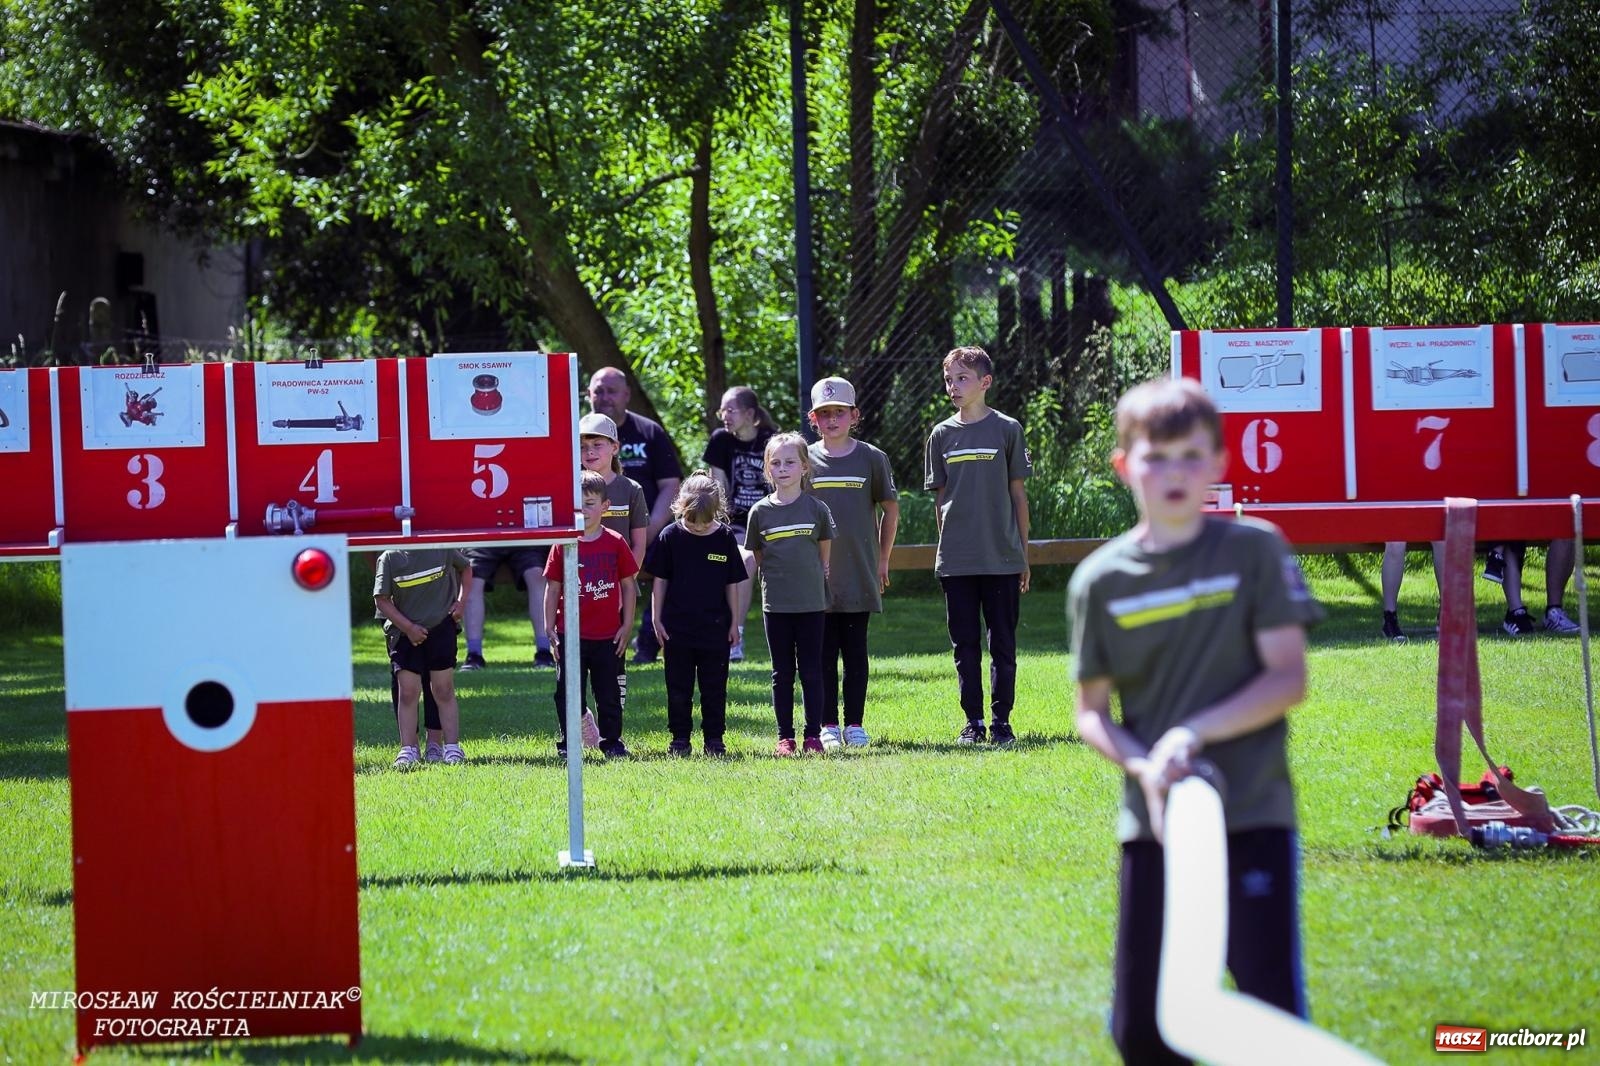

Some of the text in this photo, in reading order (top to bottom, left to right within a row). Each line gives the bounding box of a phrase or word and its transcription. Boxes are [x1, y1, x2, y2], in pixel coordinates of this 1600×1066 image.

[115, 372, 166, 380] ROZDZIELACZ
[323, 379, 364, 387] ZAMYKANA
[1241, 418, 1282, 473] 6
[1416, 415, 1450, 470] 7
[127, 453, 166, 509] 3
[298, 449, 340, 503] 4
[471, 443, 509, 499] 5
